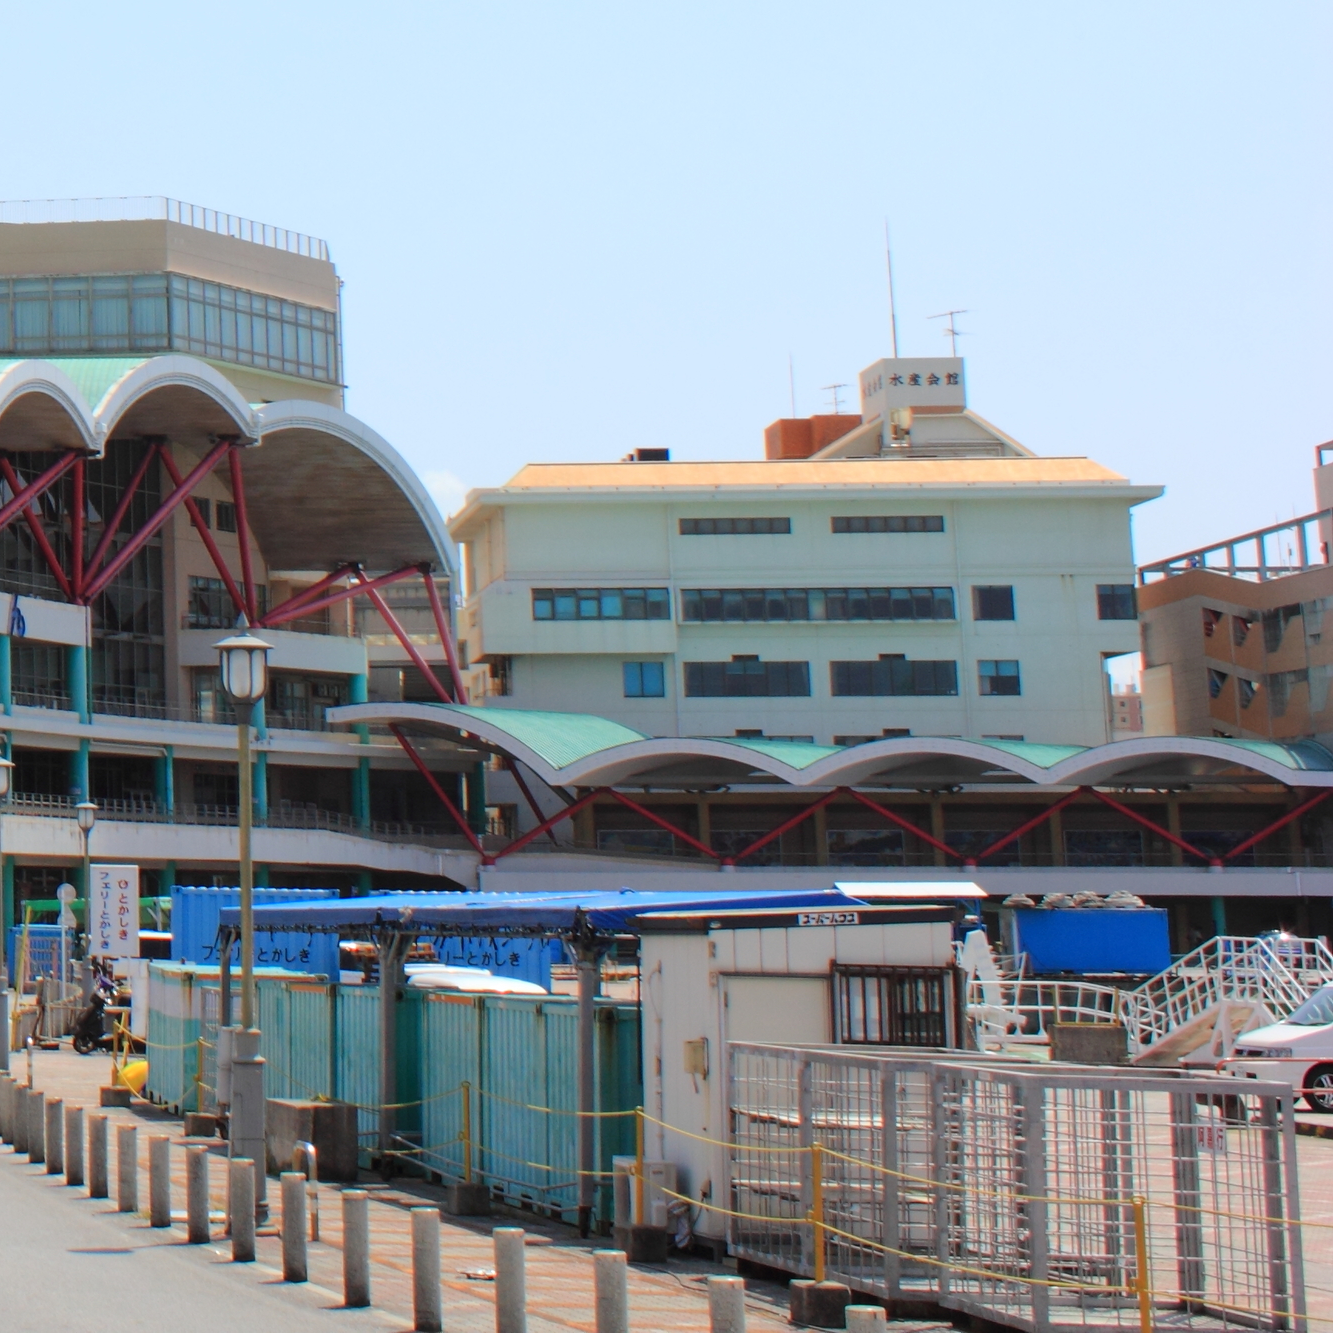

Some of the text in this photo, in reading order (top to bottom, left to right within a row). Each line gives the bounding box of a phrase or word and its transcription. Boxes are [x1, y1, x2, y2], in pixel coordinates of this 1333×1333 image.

[888, 372, 960, 387] 水産会館
[98, 871, 112, 950] フェリーとかしき
[117, 893, 130, 941] とかしき
[202, 945, 311, 964] フリとかしき
